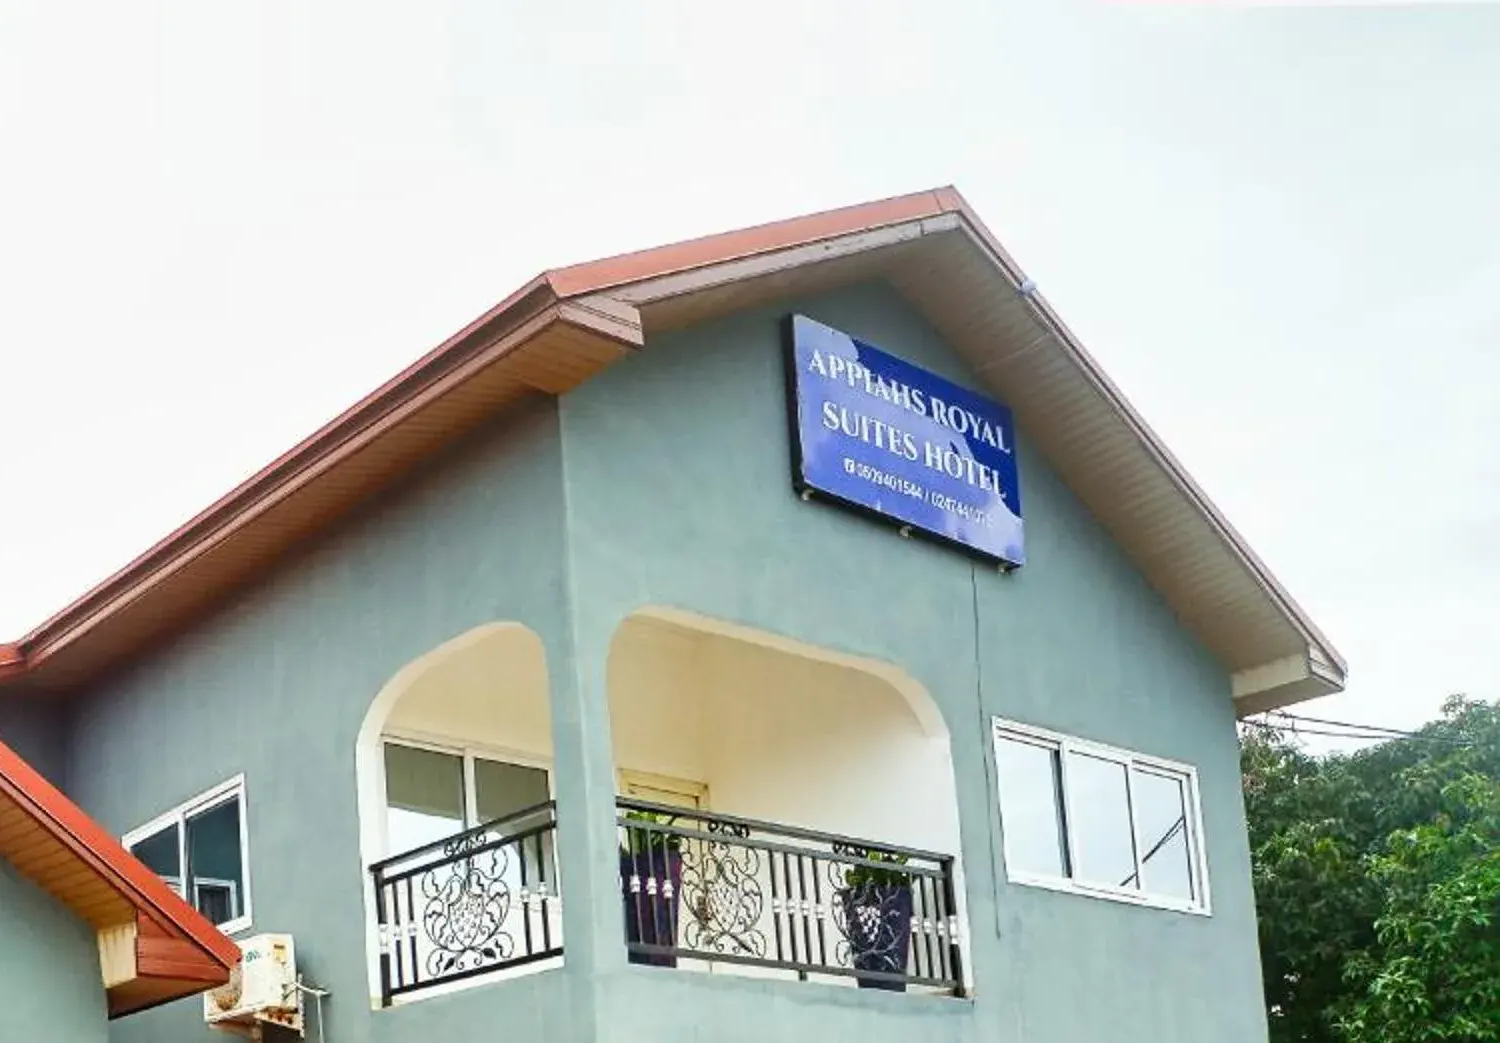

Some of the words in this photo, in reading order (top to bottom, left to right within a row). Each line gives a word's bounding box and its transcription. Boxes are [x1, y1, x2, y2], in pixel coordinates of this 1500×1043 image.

[808, 348, 927, 417] APPIAHS
[931, 397, 1011, 454] ROYAL
[823, 401, 918, 461] SUITES
[924, 440, 1007, 499] HOTEL
